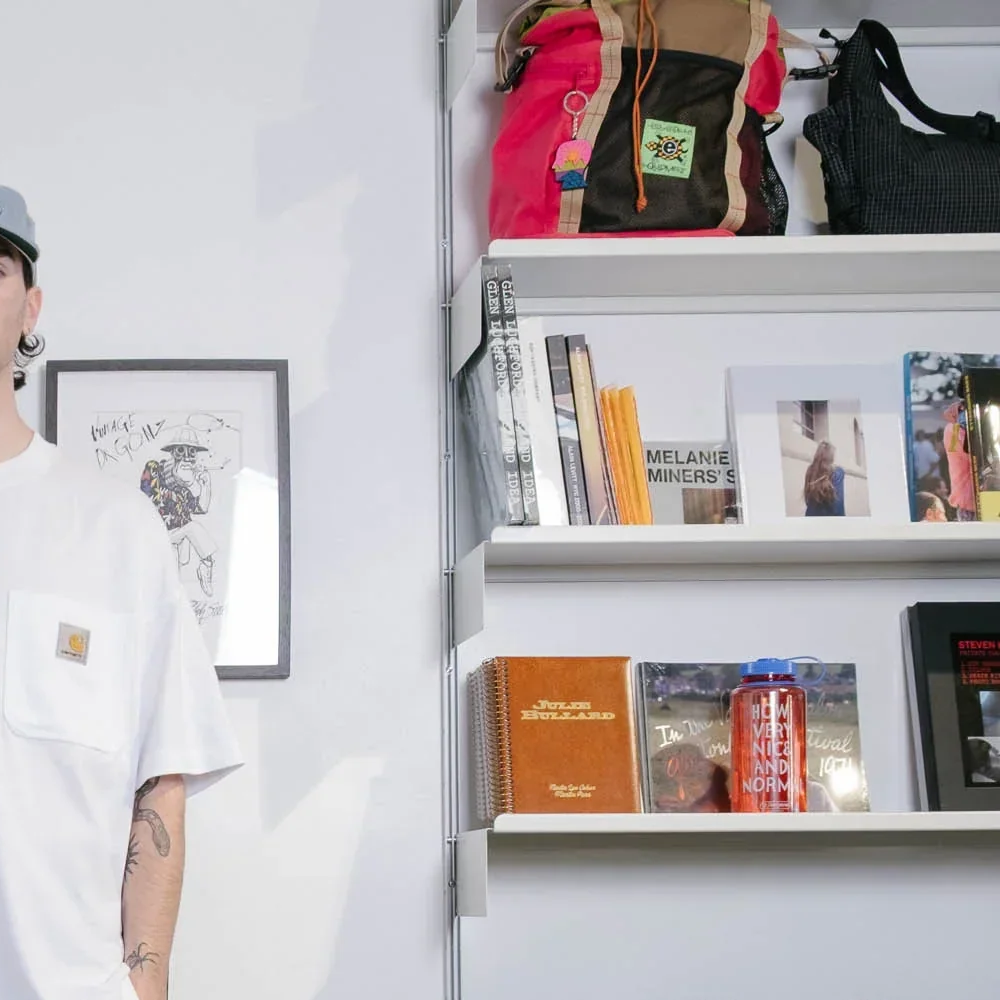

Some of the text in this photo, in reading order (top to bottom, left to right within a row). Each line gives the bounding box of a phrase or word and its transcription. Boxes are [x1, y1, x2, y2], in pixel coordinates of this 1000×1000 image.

[486, 280, 500, 315] GLEN
[501, 280, 515, 315] GLEN
[646, 449, 730, 465] MELANIE
[648, 468, 721, 484] MINERS'
[958, 640, 996, 649] STEVEN
[520, 709, 616, 721] BULLARD
[752, 704, 789, 720] HOW
[753, 723, 792, 739] VERY
[754, 760, 788, 775] AND
